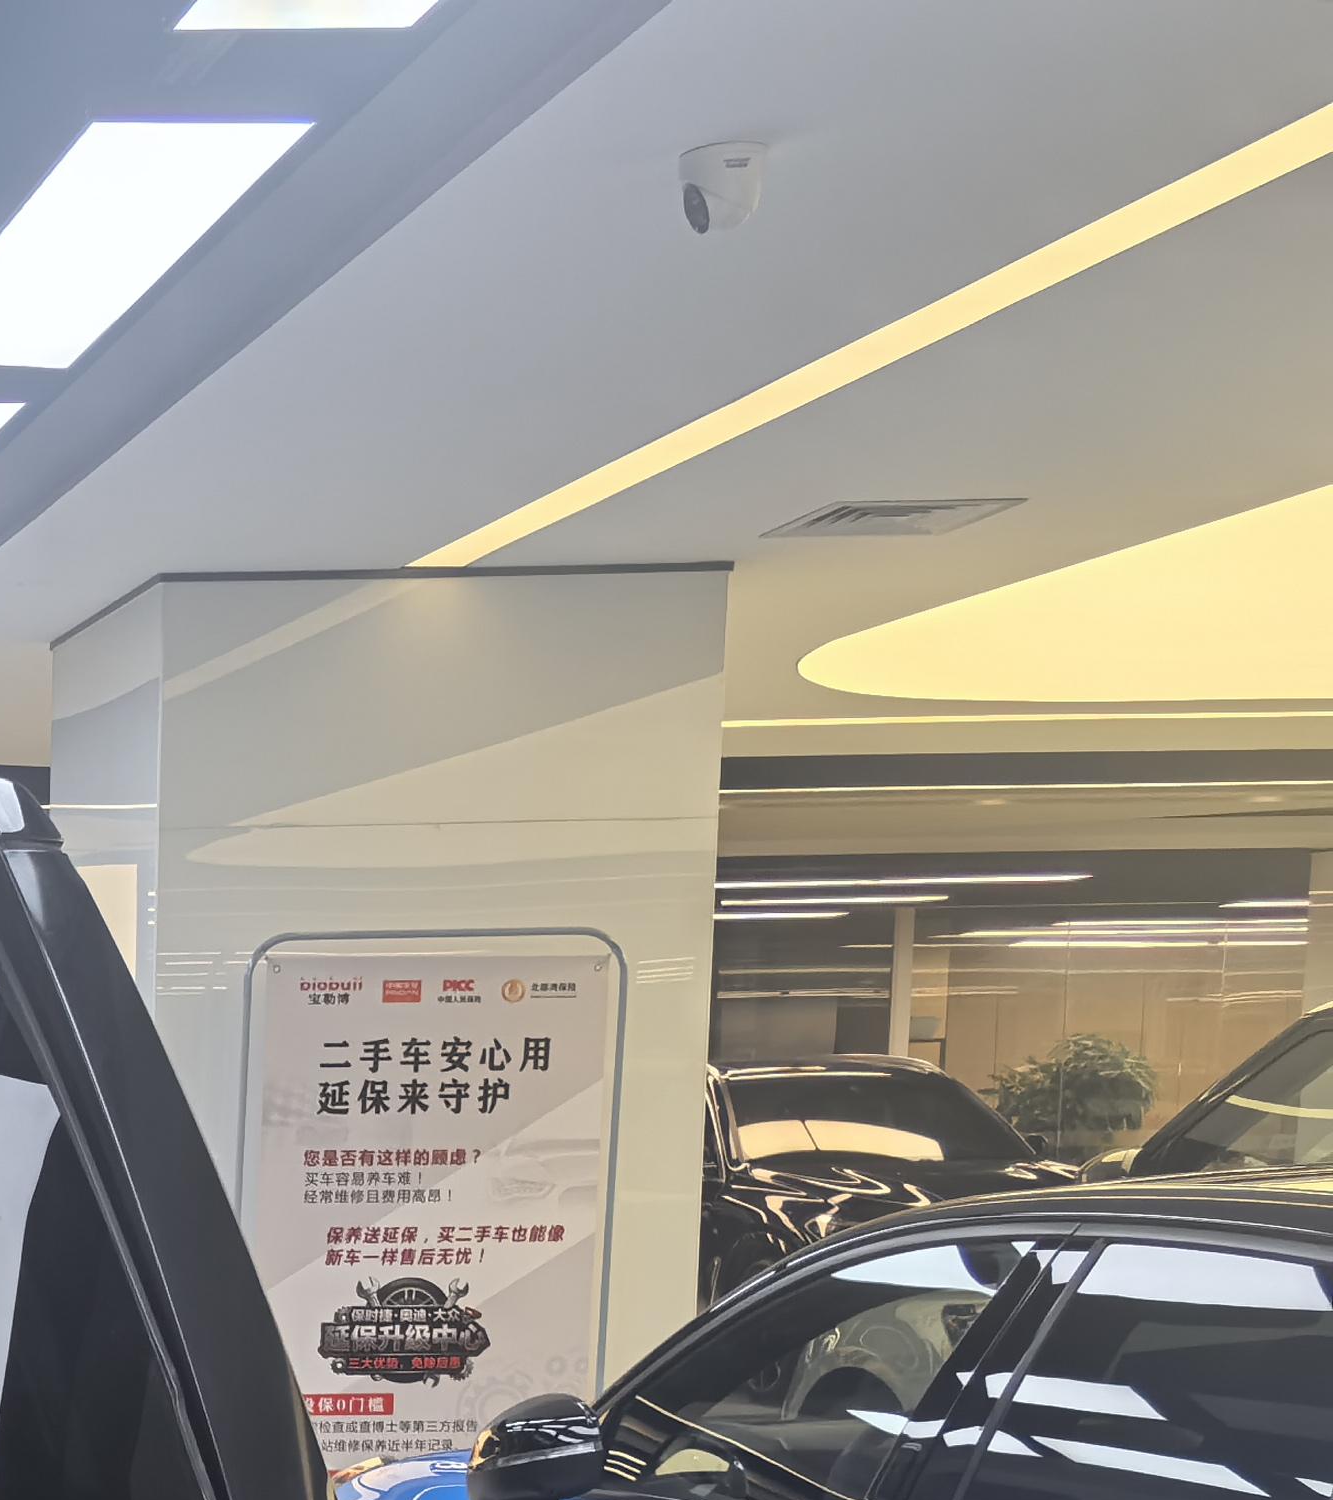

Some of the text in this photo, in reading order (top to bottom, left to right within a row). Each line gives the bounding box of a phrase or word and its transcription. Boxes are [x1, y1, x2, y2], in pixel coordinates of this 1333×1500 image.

[442, 979, 476, 992] PICC
[319, 1036, 552, 1073] 二手车安心用
[316, 1077, 511, 1115] 延保来守护
[302, 1149, 481, 1168] 您是否有这样的顾虑？
[303, 1171, 423, 1187] 买车容易养车难！
[302, 1188, 453, 1204] 经常维修且费用高昂！
[325, 1224, 566, 1246] 保养送延保，买二手车也能像
[324, 1247, 486, 1267] 新车一样售后无忧！
[322, 1323, 485, 1352] 延保升级中心
[312, 1419, 478, 1434] 检查或查博士等第三方报告
